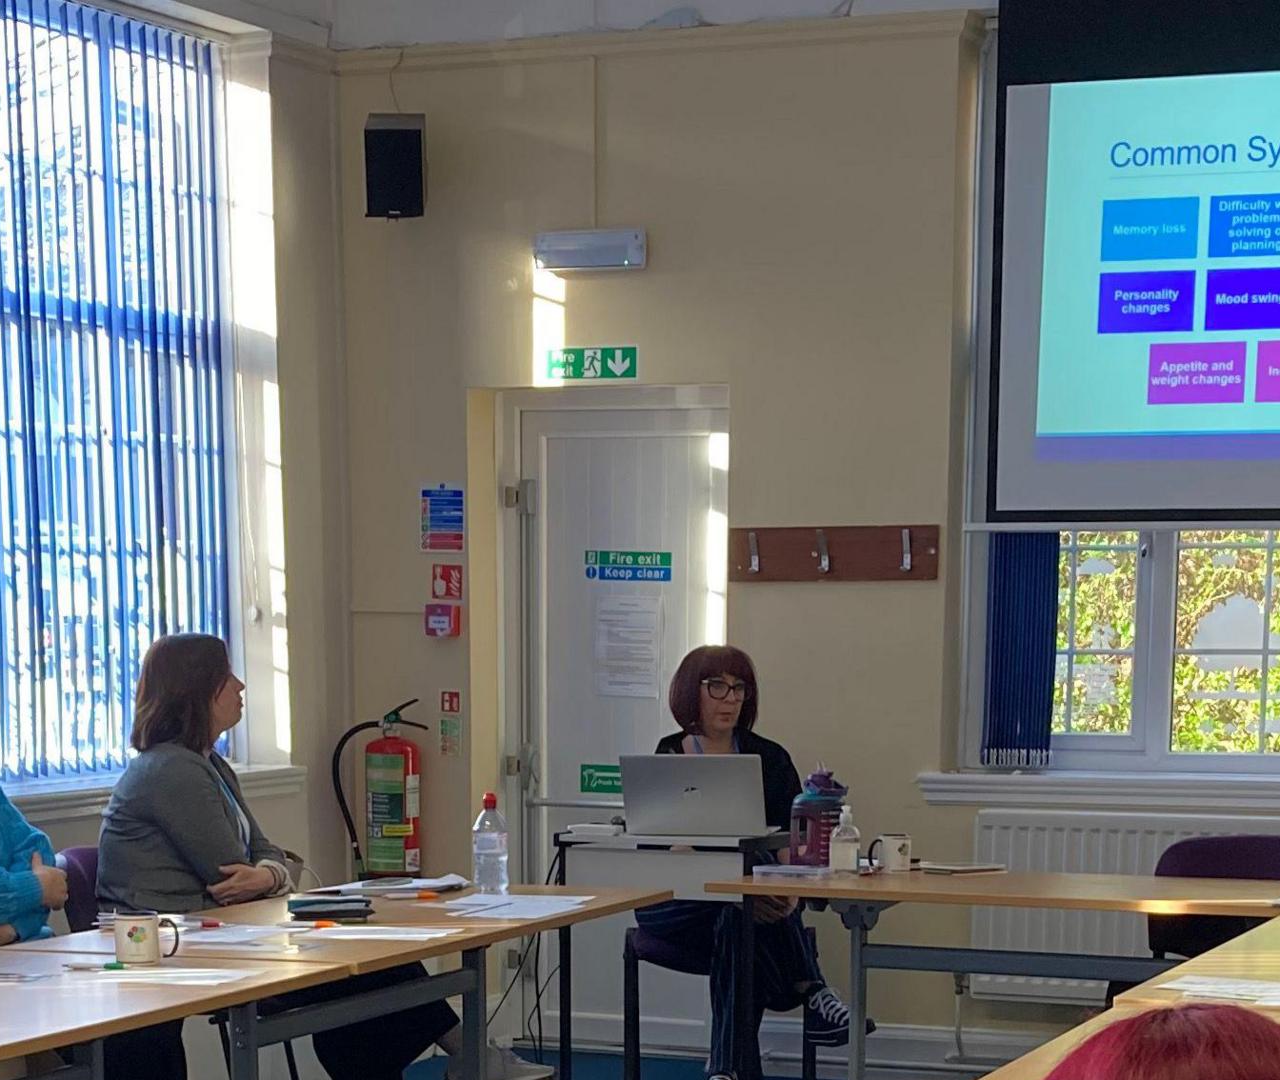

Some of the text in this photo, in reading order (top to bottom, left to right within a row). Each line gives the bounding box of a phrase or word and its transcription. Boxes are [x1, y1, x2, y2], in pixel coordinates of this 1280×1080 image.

[1110, 141, 1236, 167] Common
[1219, 199, 1271, 212] Difficulty
[1112, 223, 1187, 237] Memory loss
[1228, 226, 1271, 239] solving
[1114, 288, 1179, 302] Personality
[1215, 293, 1248, 305] Mood
[1121, 302, 1171, 315] changes
[1160, 360, 1234, 374] Appetite and
[1151, 373, 1242, 388] weight changes
[608, 552, 661, 566] Fire exit
[604, 567, 665, 580] Keep clear
